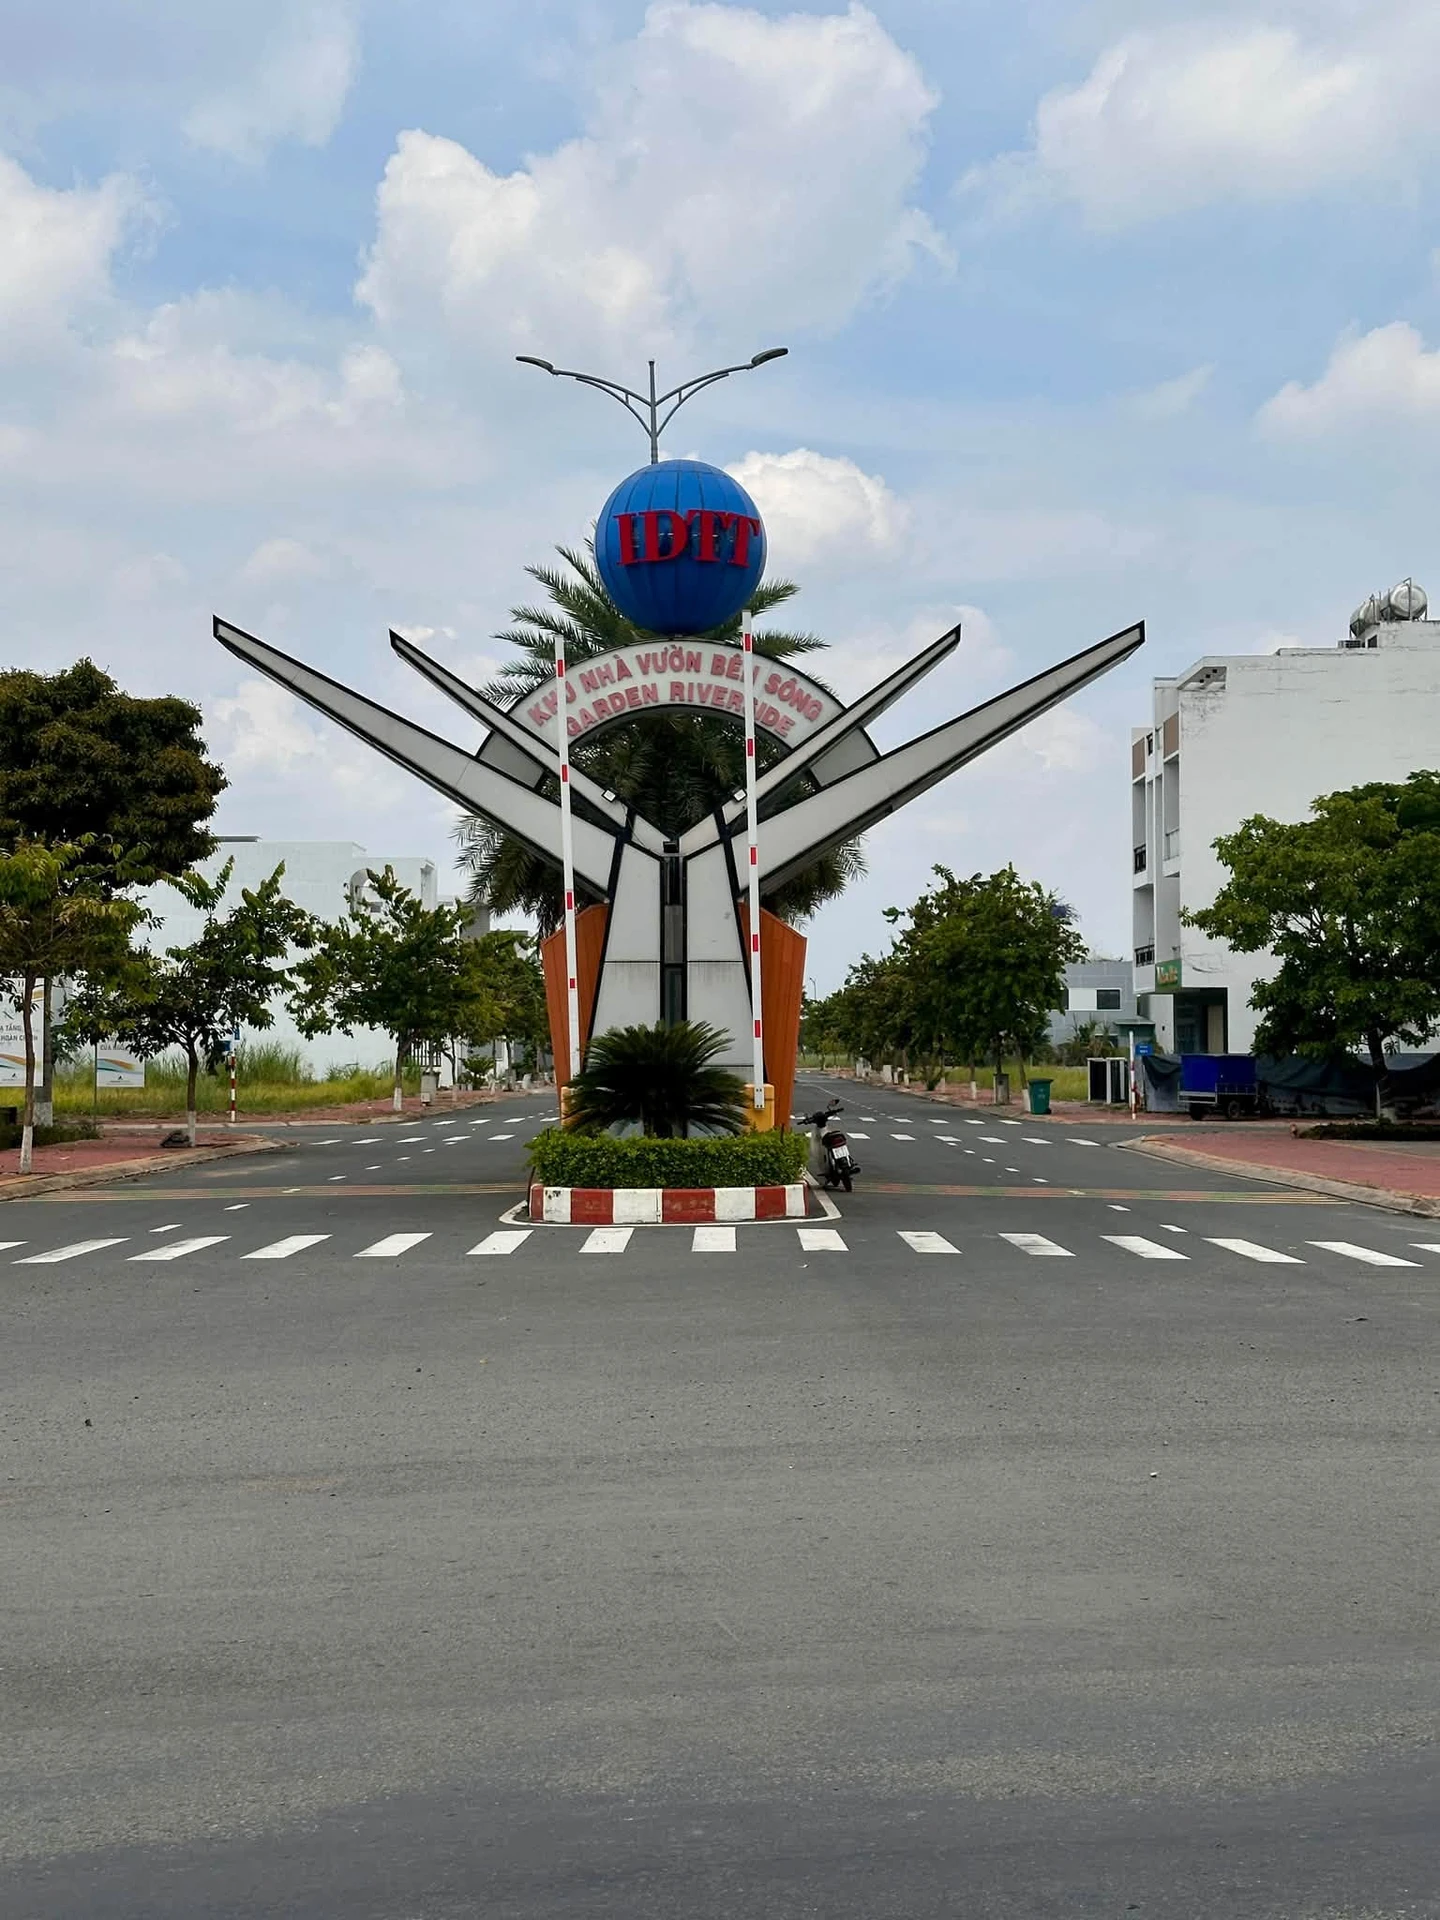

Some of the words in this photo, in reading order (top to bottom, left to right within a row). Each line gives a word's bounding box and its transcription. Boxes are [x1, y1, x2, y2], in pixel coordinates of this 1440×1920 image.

[613, 509, 761, 567] IDTT
[566, 683, 659, 737] GARDEN
[580, 654, 632, 692] NHÀ
[636, 645, 703, 675] VƯỜN
[764, 673, 823, 721] SÔNG
